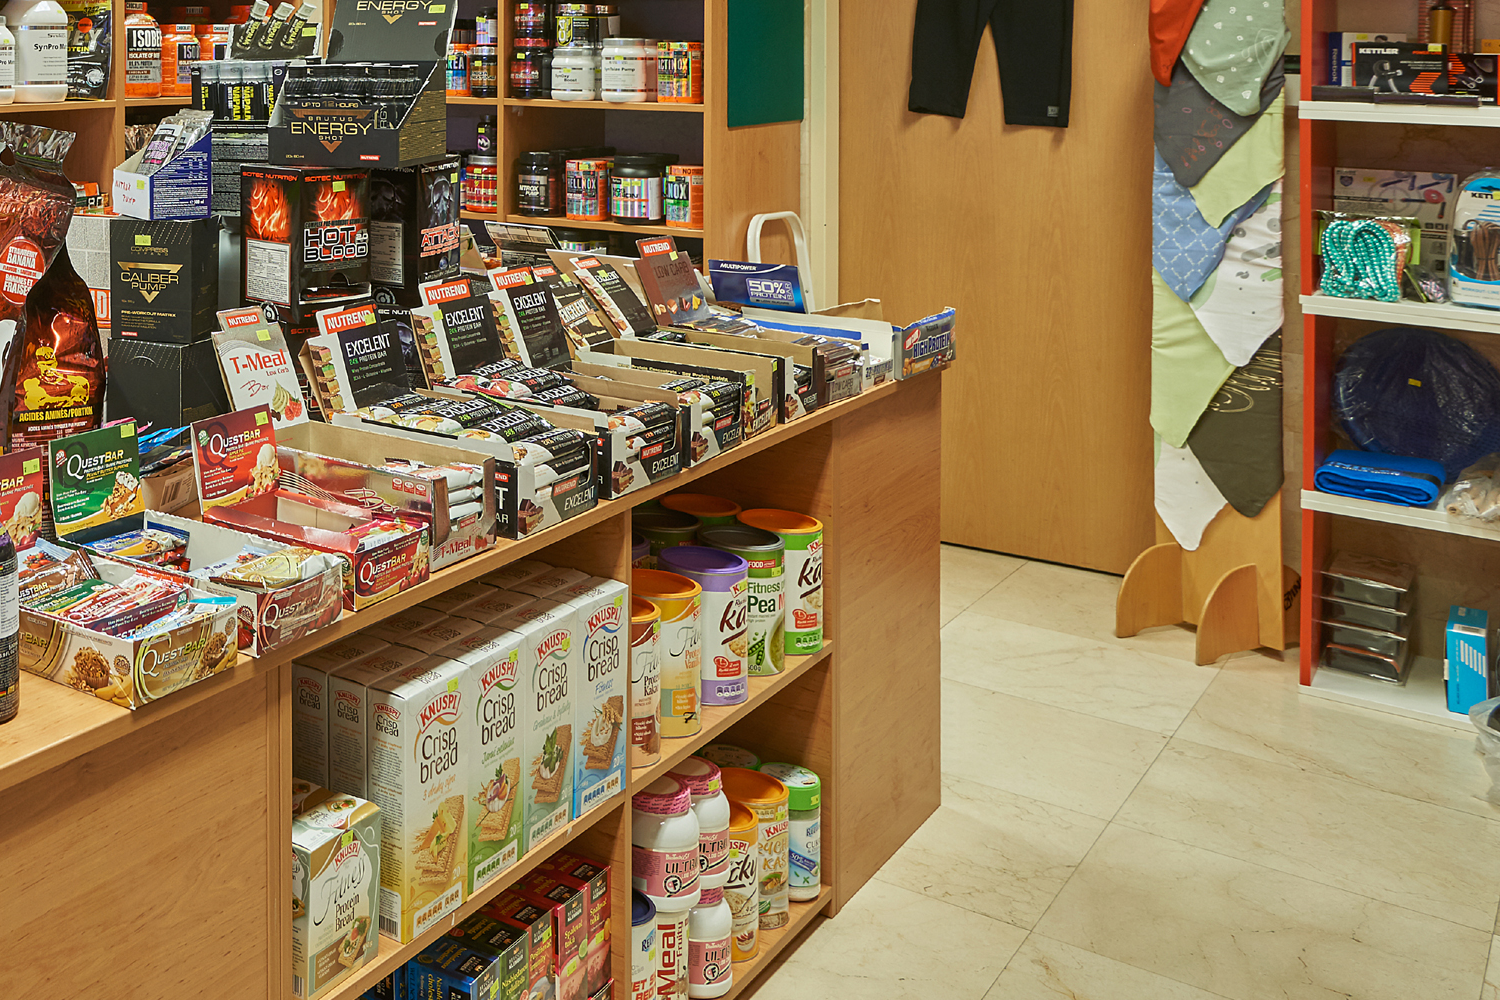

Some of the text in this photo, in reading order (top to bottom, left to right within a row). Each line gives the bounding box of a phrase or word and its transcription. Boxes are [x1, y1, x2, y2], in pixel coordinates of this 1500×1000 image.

[357, 0, 433, 12] ENERGY
[34, 43, 58, 51] SynPro
[291, 121, 372, 136] ENERGY
[303, 226, 356, 247] HOT
[304, 244, 368, 263] BLOOD
[643, 241, 670, 255] NUTREND
[7, 253, 36, 270] BANANA
[720, 263, 757, 271] MULTIPOWER
[121, 271, 179, 285] CALIBER
[131, 282, 168, 291] PUMP
[748, 280, 785, 296] 50%
[428, 284, 468, 302] NUTREND
[514, 291, 547, 311] EXCELENT
[228, 315, 259, 326] NUTREND
[445, 306, 485, 327] EXCELENT
[345, 333, 390, 358] EXCELENT
[913, 333, 951, 359] HIGH PROTEIN
[230, 351, 287, 375] T-Meal
[19, 410, 43, 422] ACIDES
[652, 452, 680, 475] EXCELENT
[564, 488, 595, 511] EXCELENT
[748, 582, 780, 593] Fitness
[748, 595, 776, 613] Pea
[587, 603, 622, 632] KNUSPI
[588, 635, 620, 663] Crisp
[480, 658, 518, 689] KNUSPI
[538, 661, 567, 690] Crisp
[587, 656, 620, 683] bread
[418, 692, 460, 724] KNUSPI
[536, 682, 569, 713] bread
[483, 693, 515, 724] Crisp
[480, 716, 516, 747] bread
[421, 726, 457, 759] Crisp
[420, 750, 459, 784] bread
[335, 894, 360, 918] Protein
